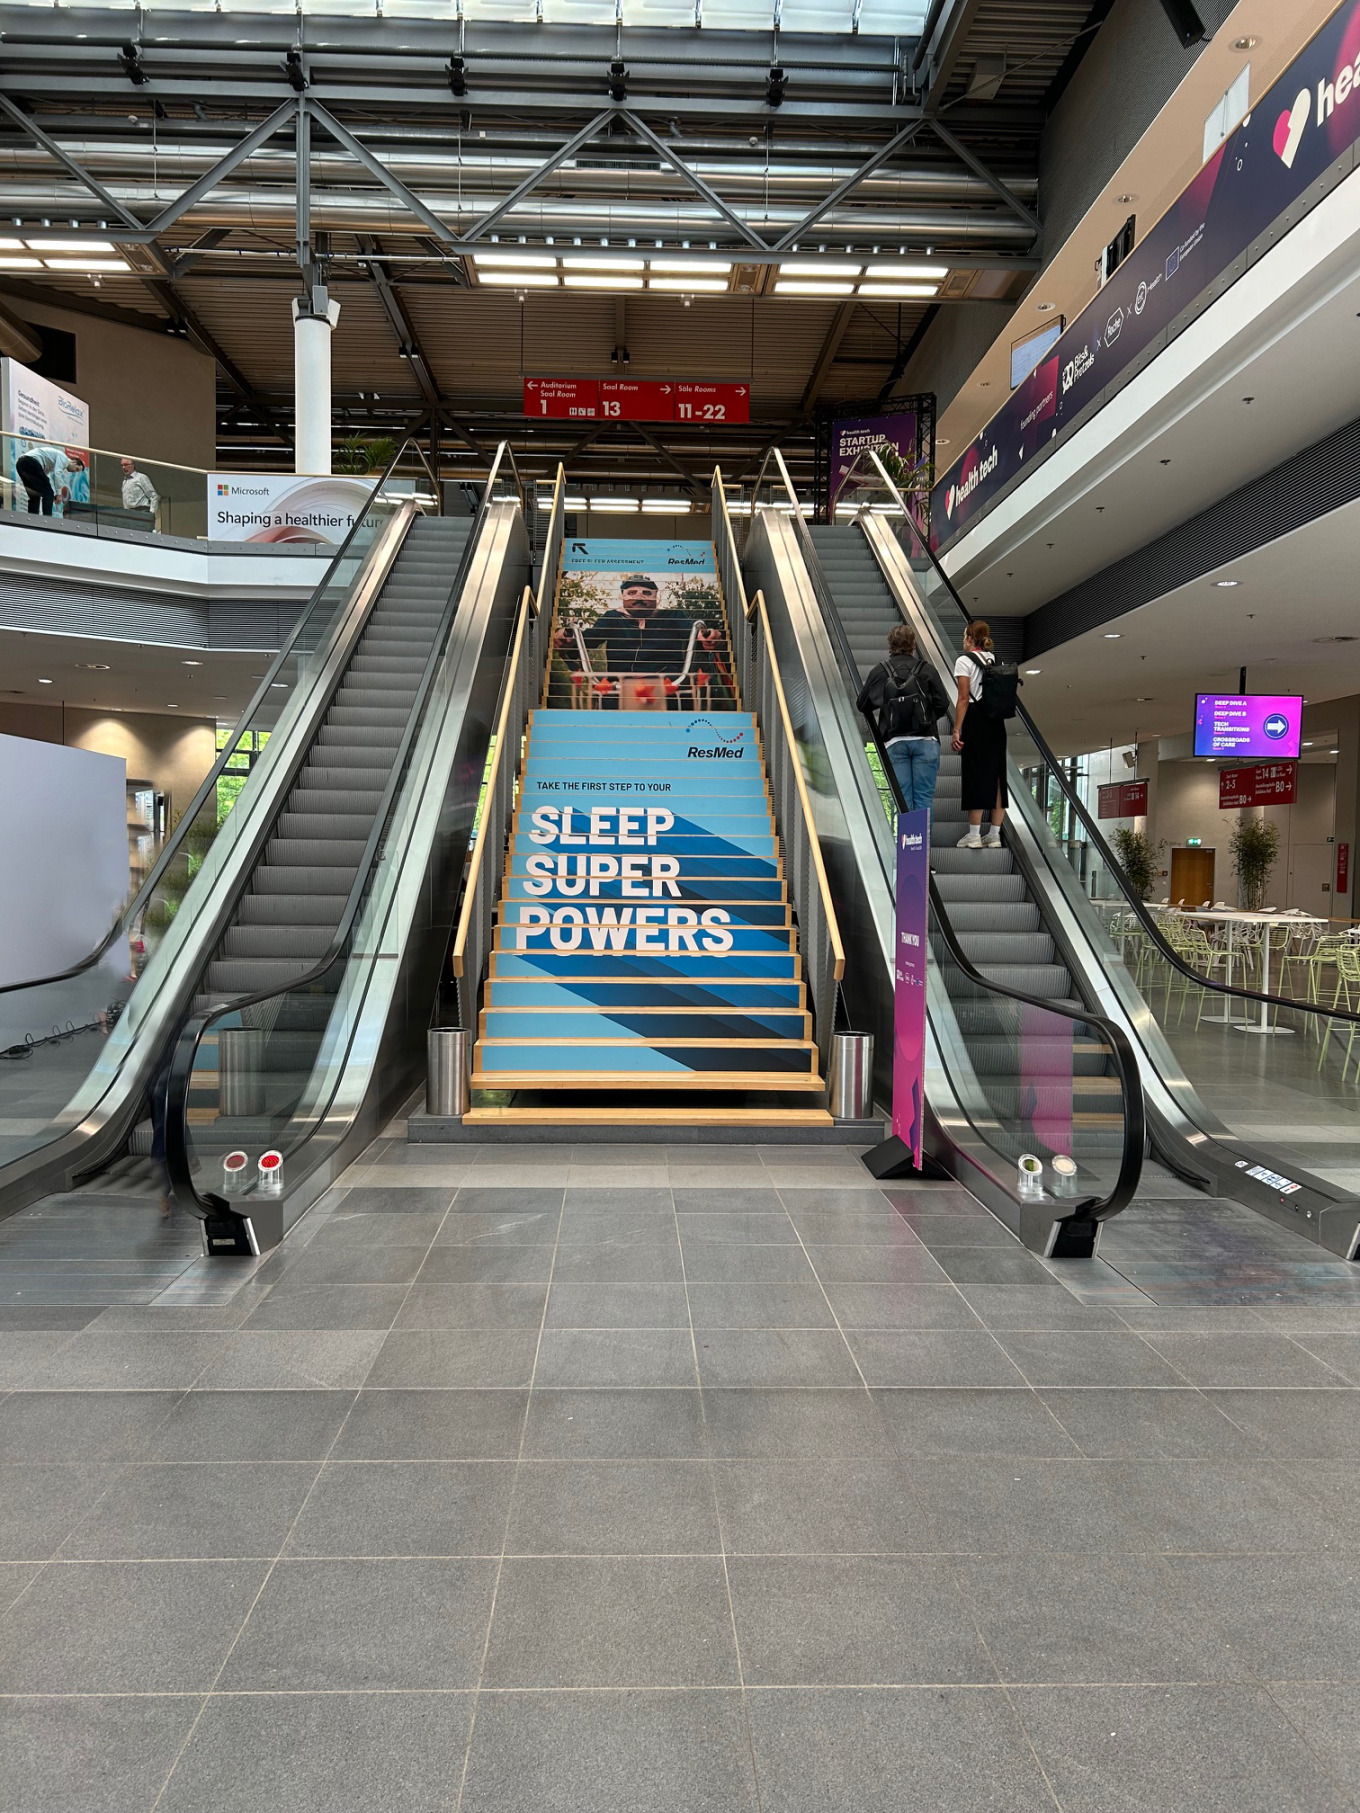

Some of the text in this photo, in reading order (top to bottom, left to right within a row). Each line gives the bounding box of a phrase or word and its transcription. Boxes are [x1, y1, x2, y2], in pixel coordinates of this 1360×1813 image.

[1107, 317, 1121, 338] Roche
[1075, 345, 1088, 369] Bits&
[1074, 352, 1095, 382] Pretzels
[540, 381, 577, 389] Auditorium
[694, 385, 716, 393] Rooms
[540, 399, 547, 415] 1
[602, 401, 621, 417] 13
[839, 433, 886, 447] STARTUP
[955, 444, 998, 507] health tech
[231, 486, 270, 496] Microsoft
[217, 511, 271, 527] Shaping
[274, 515, 282, 525] a
[285, 513, 344, 527] healthier
[687, 746, 744, 758] ResMed
[1262, 767, 1269, 779] 14
[537, 781, 671, 791] TAKE THE FIRST STEP TO YOUR
[1225, 779, 1236, 790] 2-5
[528, 805, 675, 846] SLEEP
[522, 853, 682, 897] SUPER
[515, 906, 734, 957] POWERS
